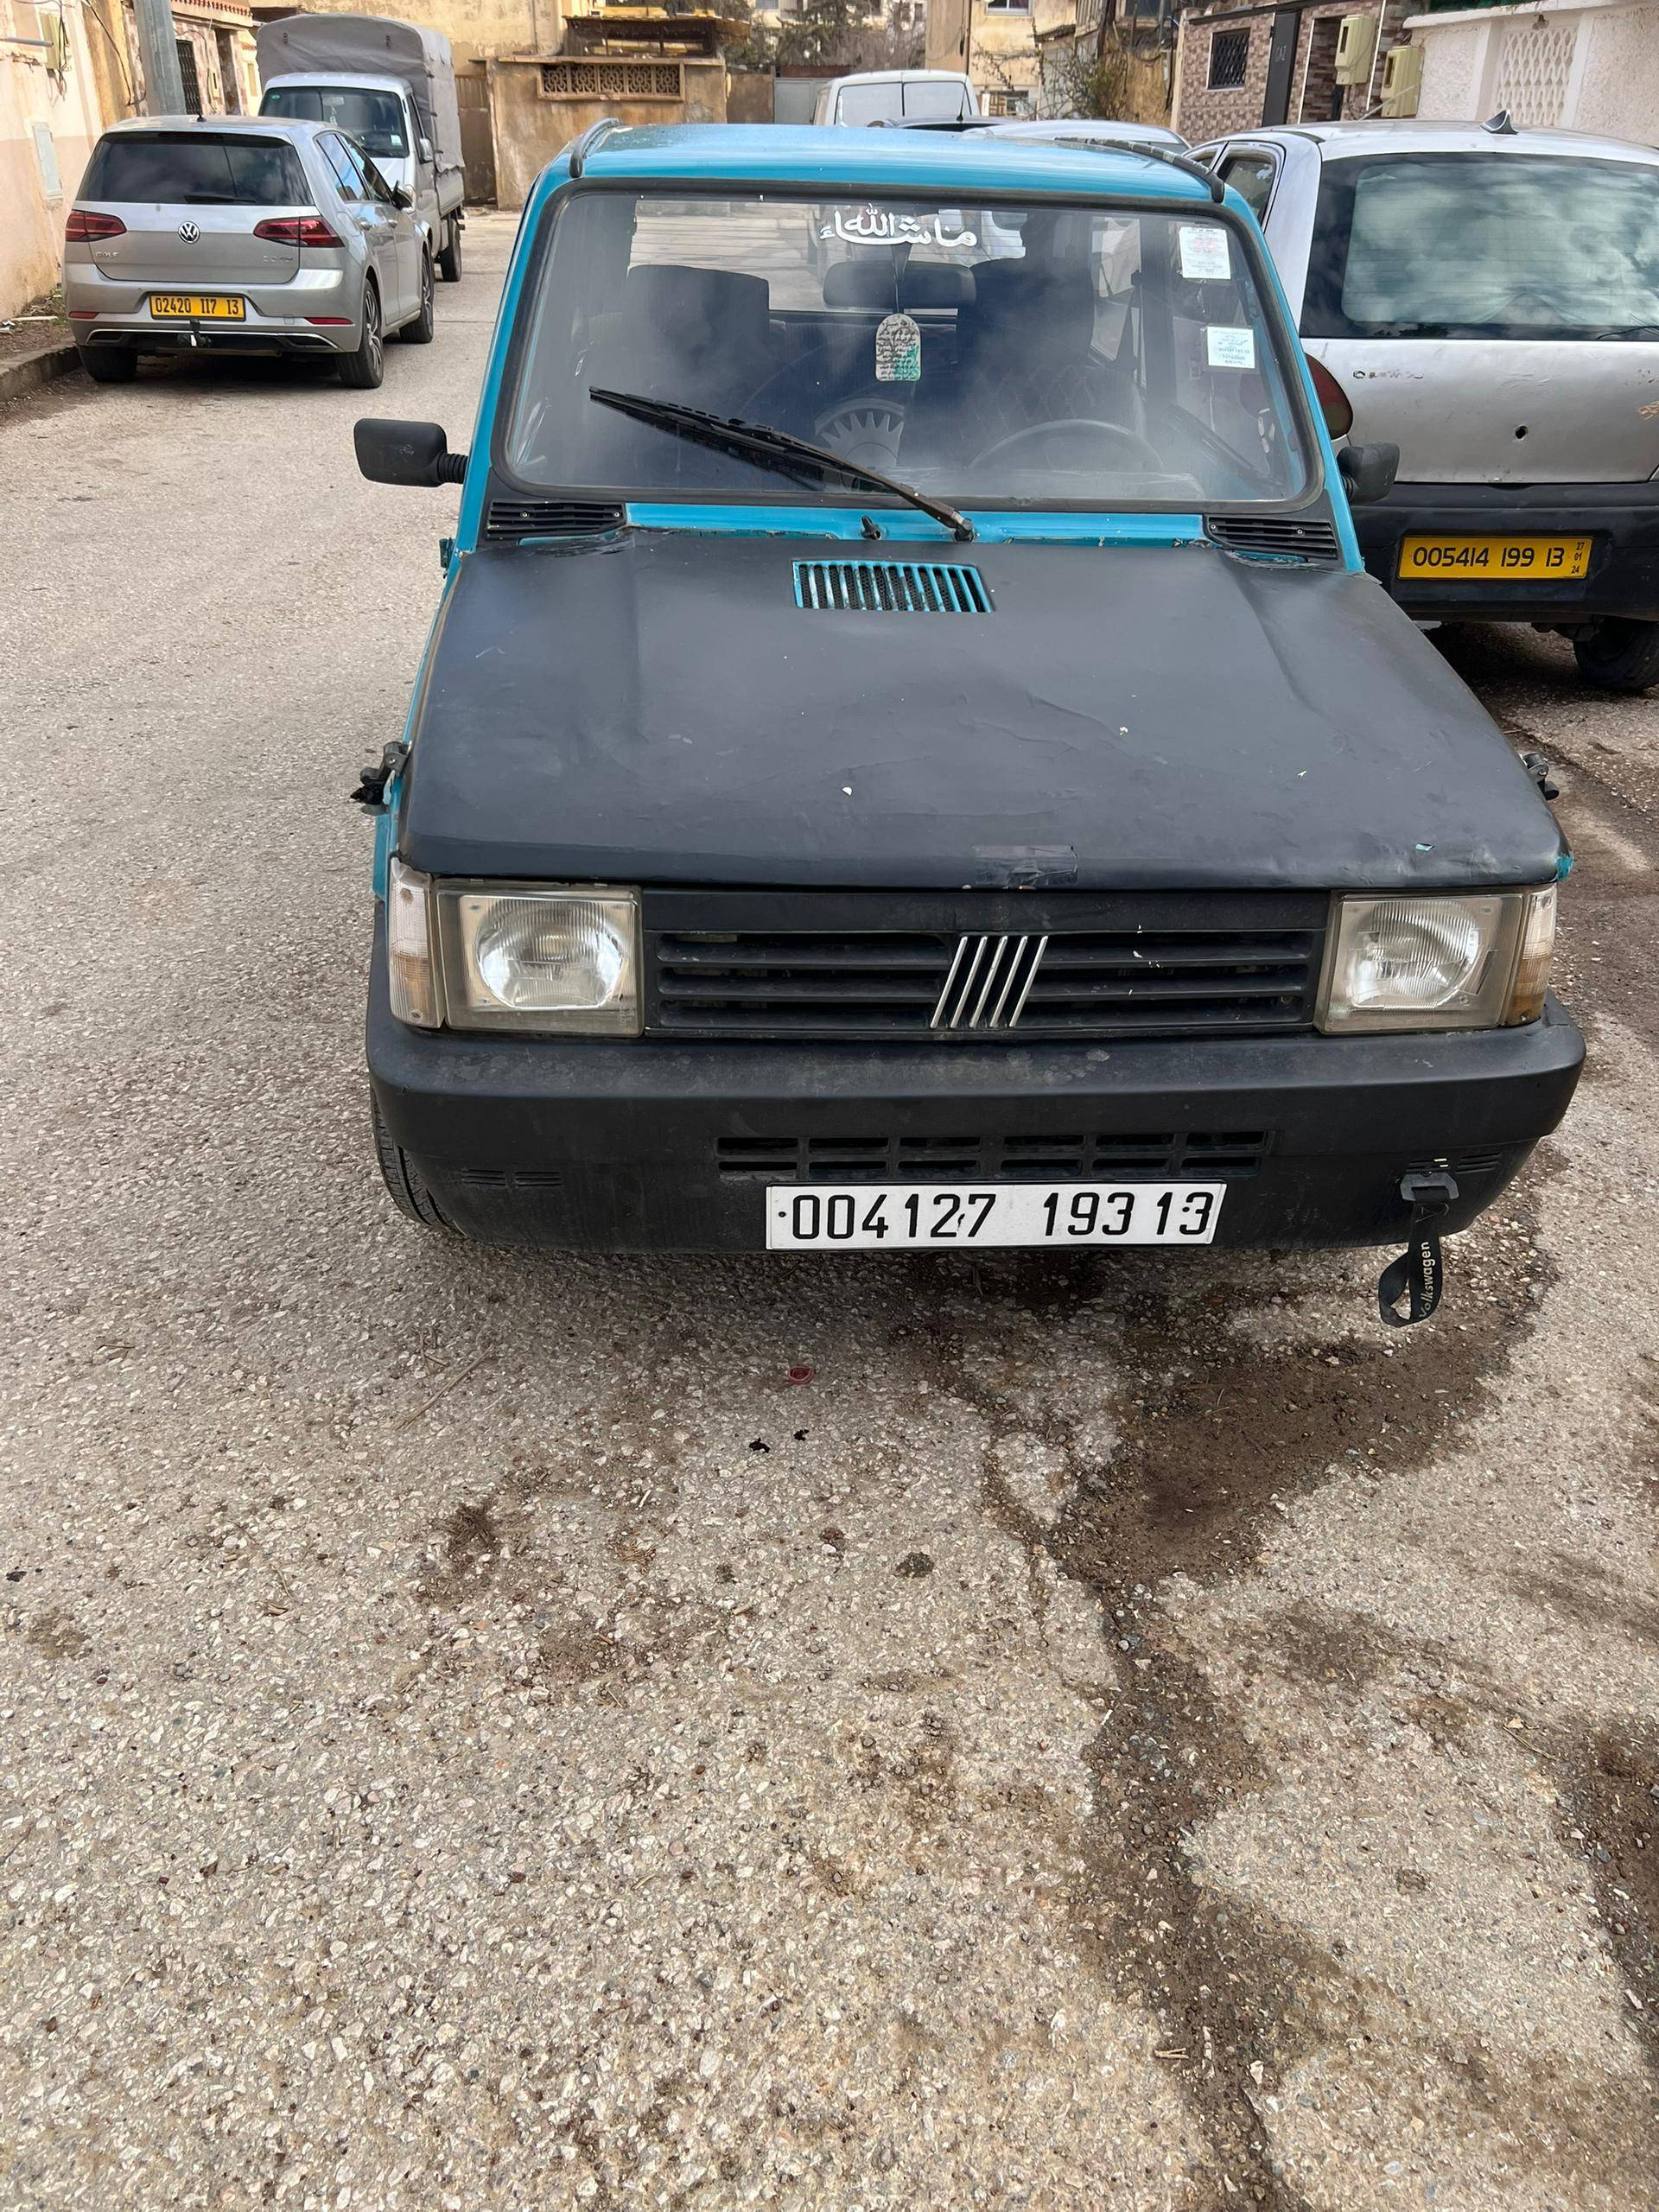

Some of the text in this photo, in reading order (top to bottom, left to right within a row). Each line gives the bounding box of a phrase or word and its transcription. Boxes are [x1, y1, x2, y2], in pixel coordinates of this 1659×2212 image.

[844, 203, 895, 237] الله
[156, 297, 238, 315] 02420 117 13
[1576, 542, 1585, 550] 27
[1413, 546, 1565, 568] 005414 199 13
[1573, 552, 1582, 561] 01
[1571, 565, 1580, 574] 24
[791, 1191, 1214, 1240] 004127 193 13
[1419, 1241, 1436, 1318] Volkswagen
